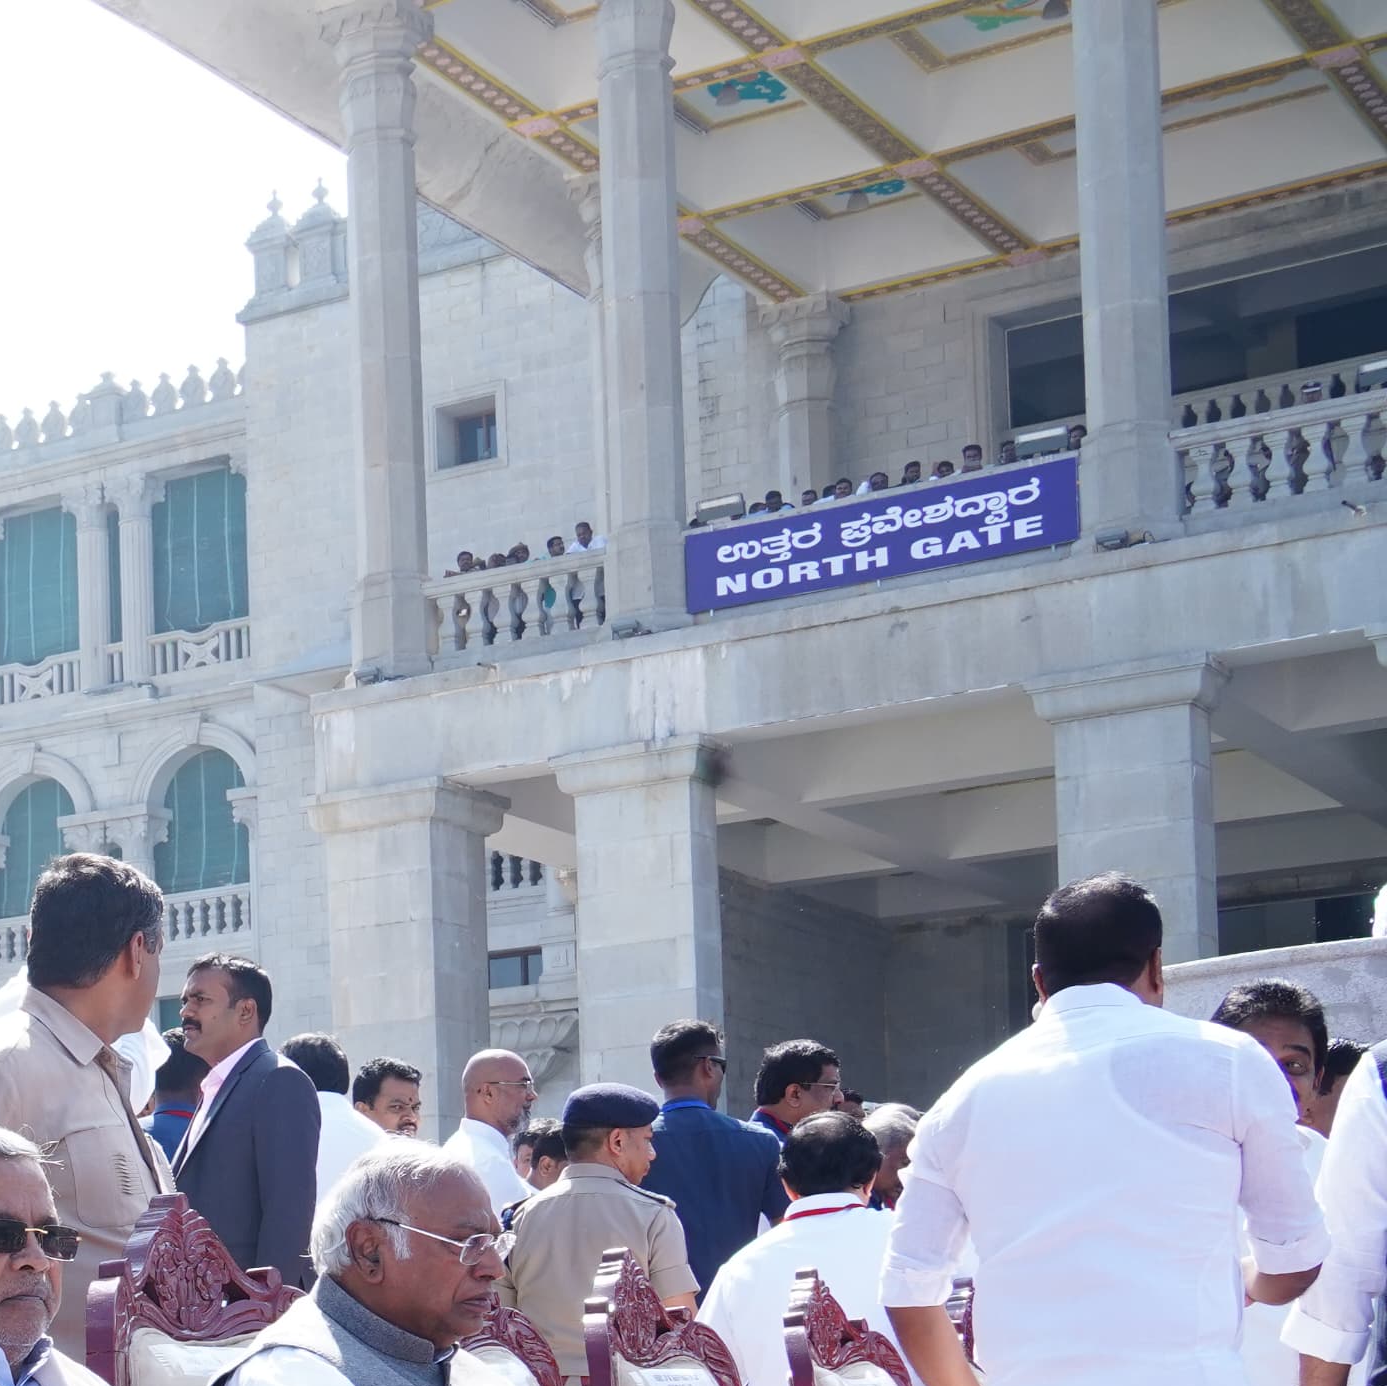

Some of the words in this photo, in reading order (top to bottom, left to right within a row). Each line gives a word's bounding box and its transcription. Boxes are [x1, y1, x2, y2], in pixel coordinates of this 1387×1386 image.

[716, 521, 822, 564] ಉತ್ತರ
[840, 477, 1040, 548] ಪ್ರವೇಶದ್ವಾರ
[716, 546, 889, 597] NORTH
[910, 514, 1044, 560] GATE
